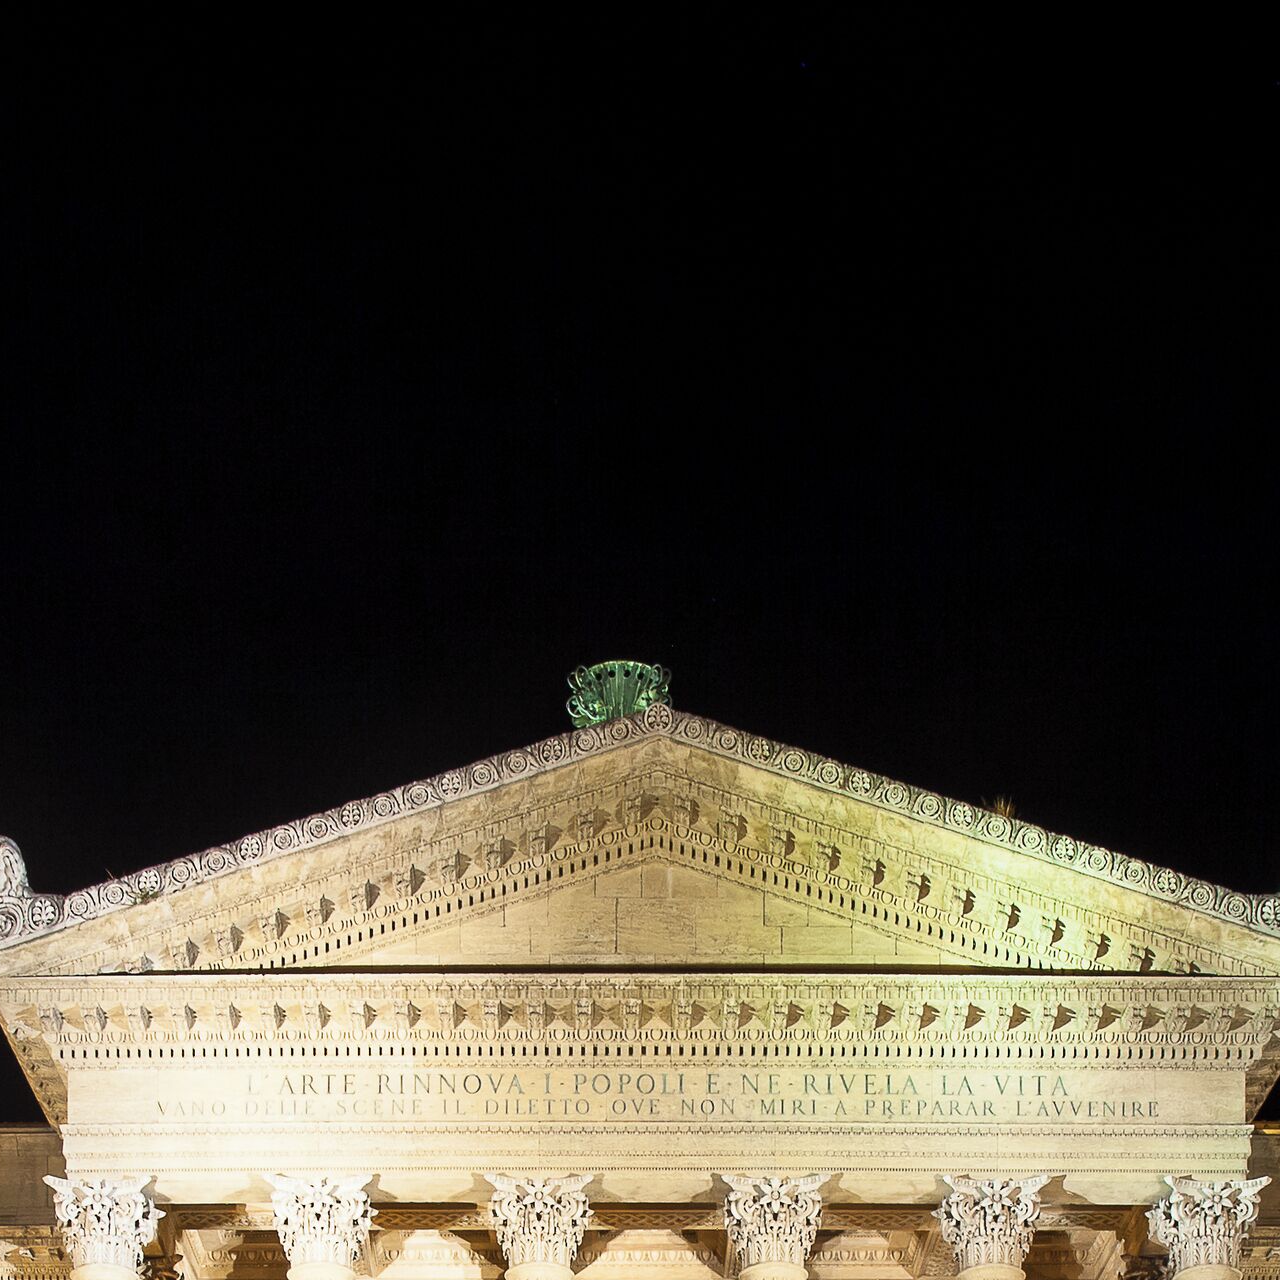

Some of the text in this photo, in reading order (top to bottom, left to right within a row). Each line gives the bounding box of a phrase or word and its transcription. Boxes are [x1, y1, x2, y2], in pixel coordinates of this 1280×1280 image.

[247, 1072, 1069, 1096] L'ARTE RINNOVA I POPOLI E NE RIVELA LA VITA
[156, 1099, 227, 1117] VANO
[335, 1098, 424, 1116] SCENE
[442, 1098, 467, 1116] IL
[484, 1098, 591, 1116] DILETTO
[611, 1098, 661, 1116] OVE
[680, 1098, 737, 1116] NON
[760, 1099, 818, 1116] MIRI
[834, 1099, 848, 1116] A
[865, 1099, 998, 1117] PREPARAR
[1016, 1100, 1160, 1118] L'AVVENIRE
